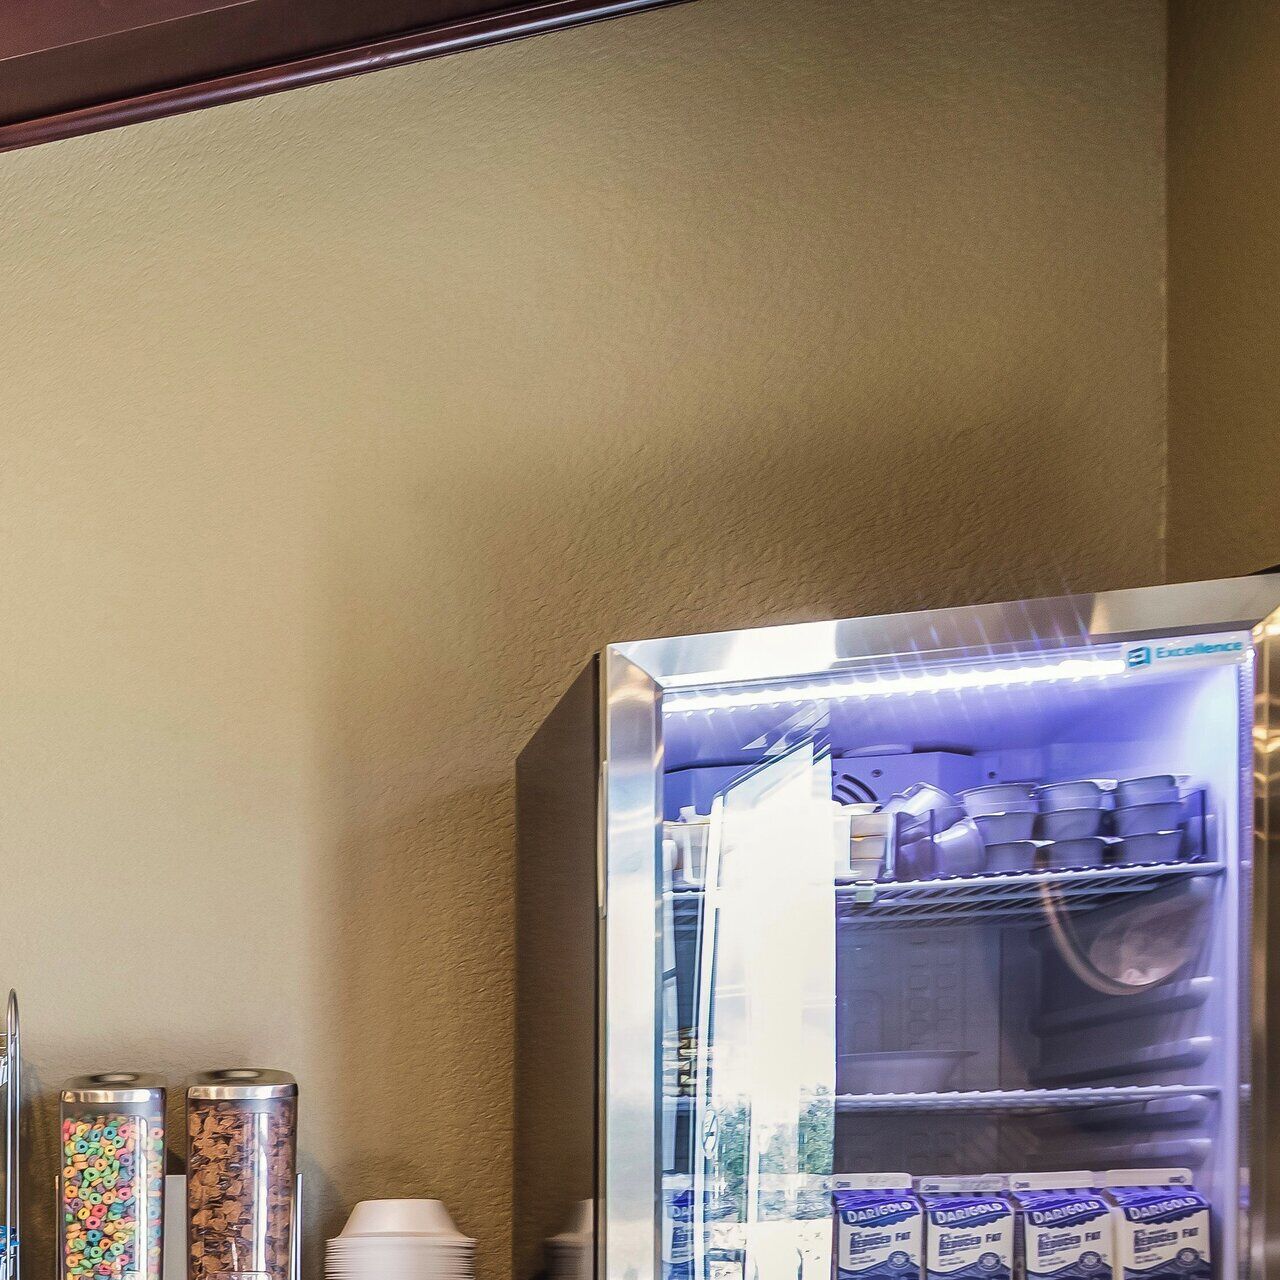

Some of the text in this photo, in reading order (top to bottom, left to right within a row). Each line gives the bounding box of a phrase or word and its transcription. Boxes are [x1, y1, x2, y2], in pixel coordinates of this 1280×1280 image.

[1156, 641, 1243, 659] Excellence
[846, 1201, 913, 1223] DARIGOLD
[936, 1202, 1003, 1224] DARIGOLD
[1033, 1201, 1100, 1224] DARIGOLD
[1128, 1197, 1197, 1220] DARIGOLD
